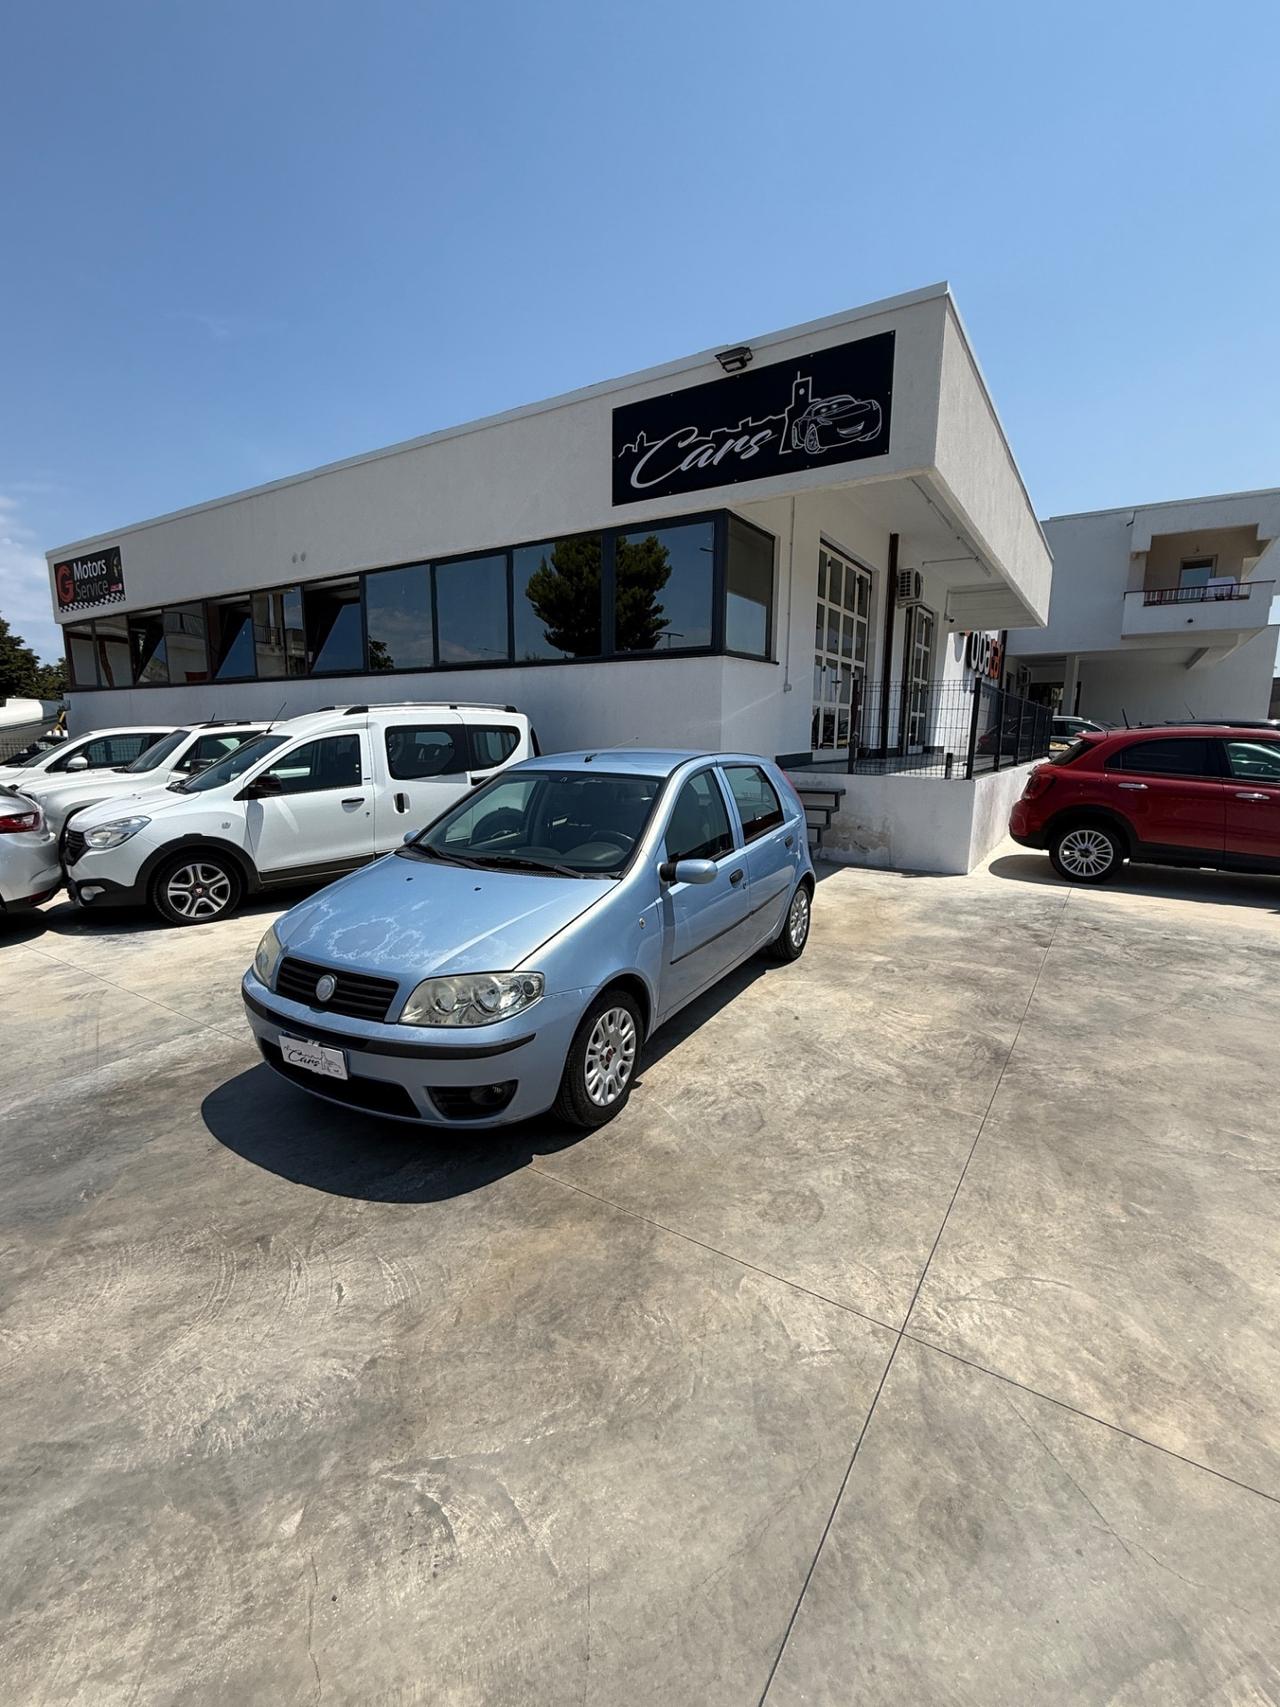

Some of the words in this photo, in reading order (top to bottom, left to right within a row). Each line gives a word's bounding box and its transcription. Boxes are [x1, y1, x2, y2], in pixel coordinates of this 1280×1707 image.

[630, 426, 778, 488] Cars
[73, 559, 107, 581] Motors
[75, 580, 109, 600] Service
